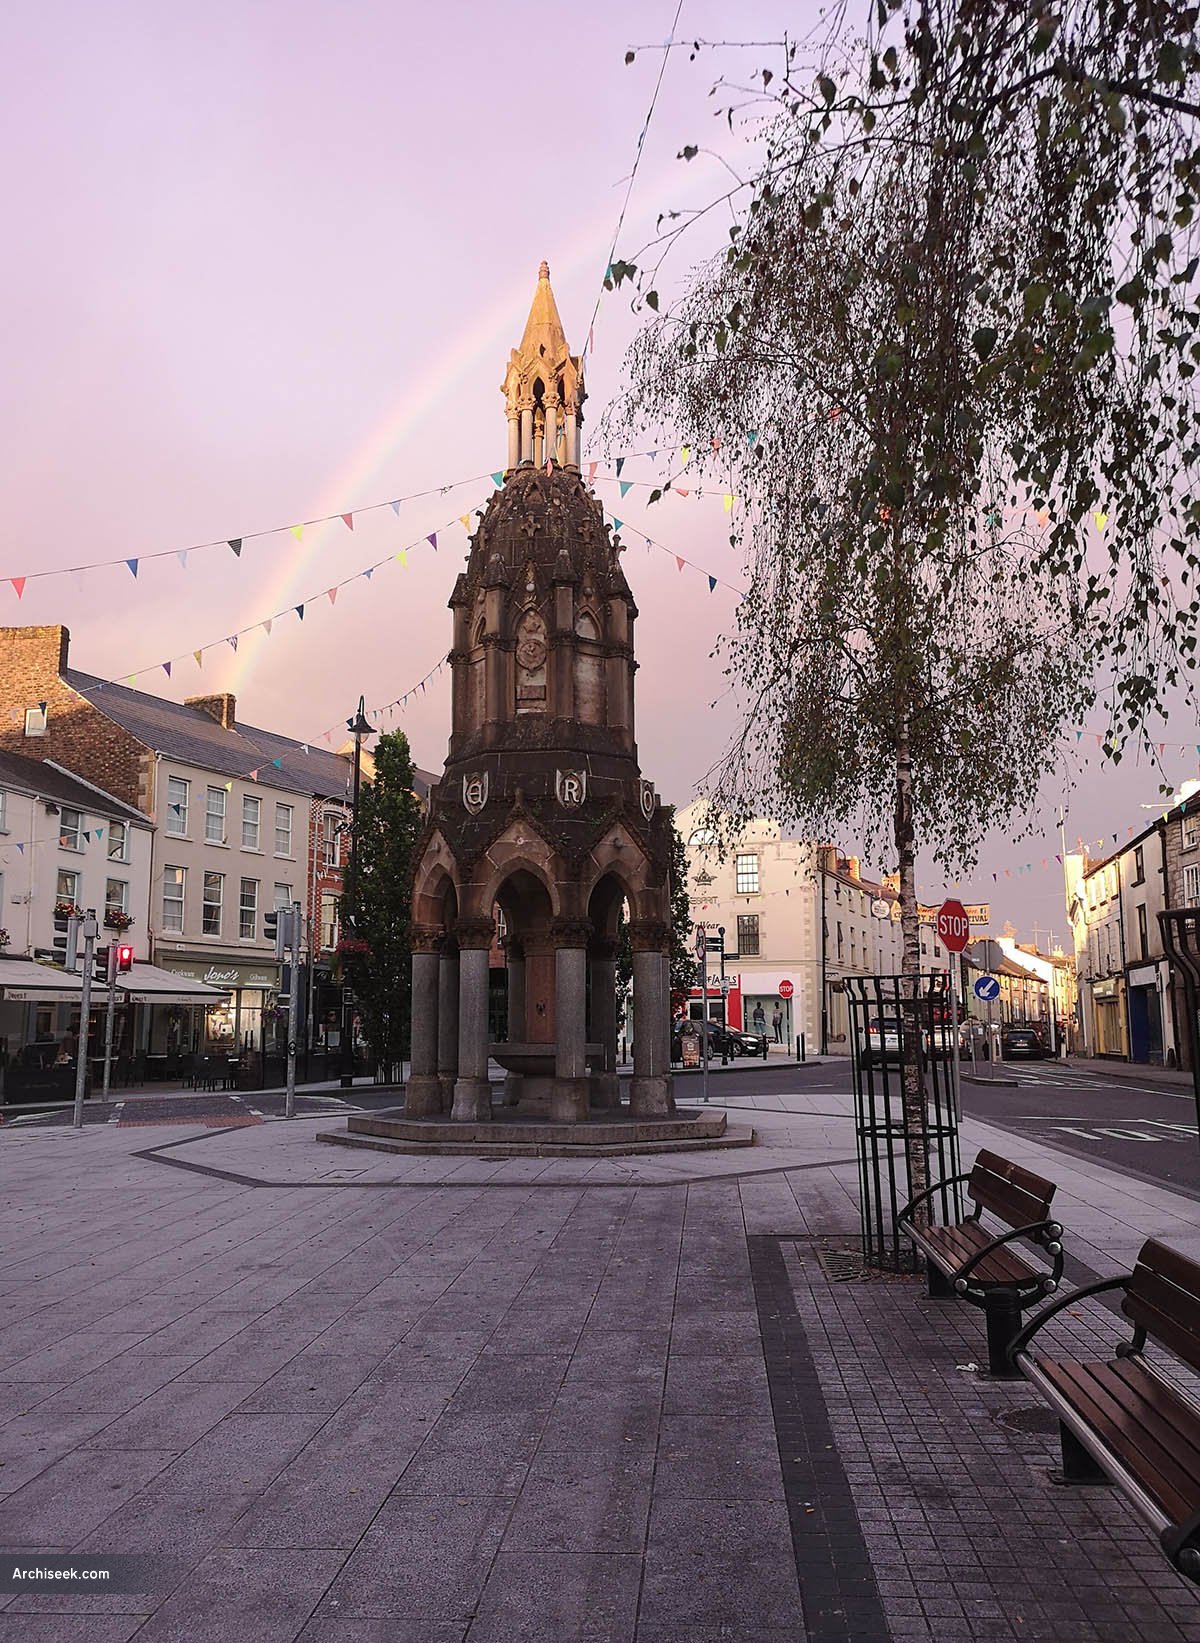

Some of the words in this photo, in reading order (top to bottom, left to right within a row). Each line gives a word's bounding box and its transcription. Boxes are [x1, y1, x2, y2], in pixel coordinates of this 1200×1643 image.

[564, 779, 580, 803] R
[940, 915, 968, 937] STOP
[780, 985, 793, 993] STOP
